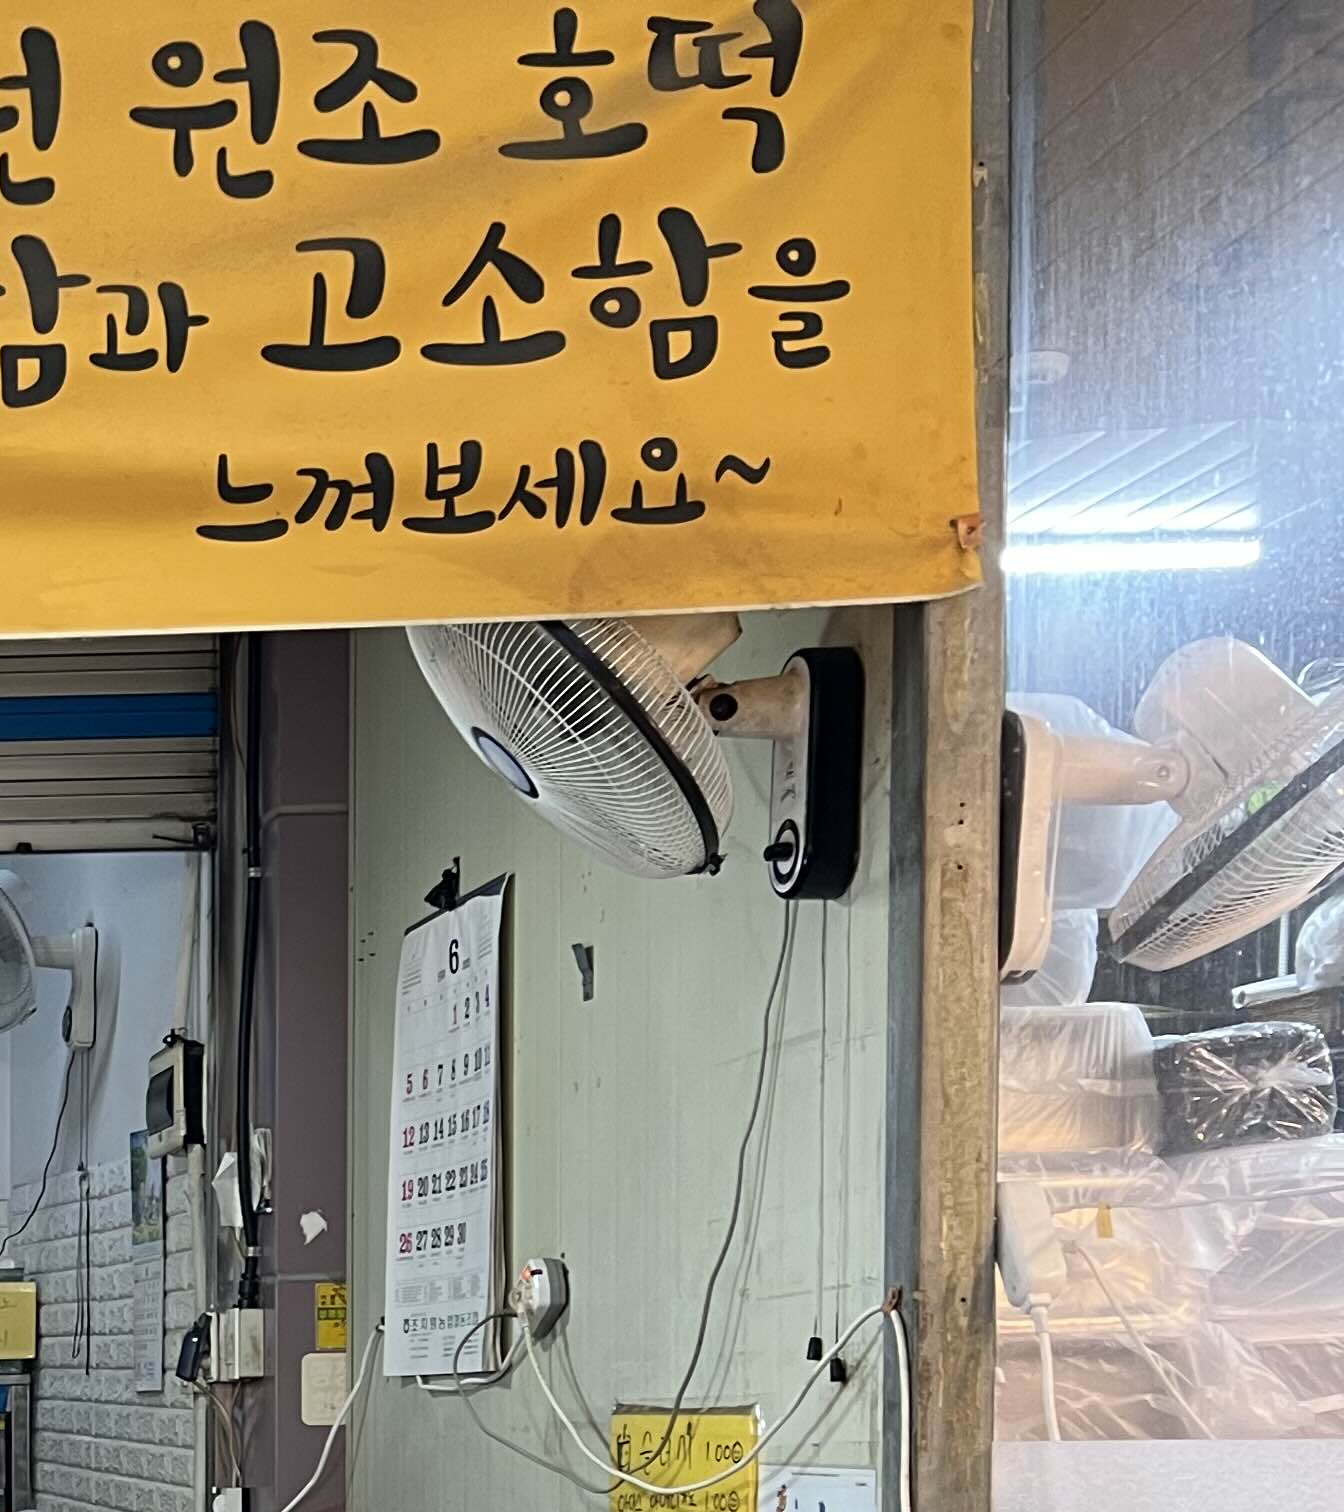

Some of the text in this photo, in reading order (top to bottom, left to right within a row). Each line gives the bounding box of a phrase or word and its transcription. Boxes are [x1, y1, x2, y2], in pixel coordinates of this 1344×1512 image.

[128, 20, 441, 200] 원조
[498, 0, 805, 174] 호떡
[261, 207, 851, 380] 고소함을
[449, 939, 459, 974] 6
[406, 1064, 443, 1095] 5 6 7
[403, 1114, 457, 1148] 12 13 14 15
[402, 1169, 456, 1201] 19 20 21 22
[399, 1224, 454, 1254] 26 27 28 29
